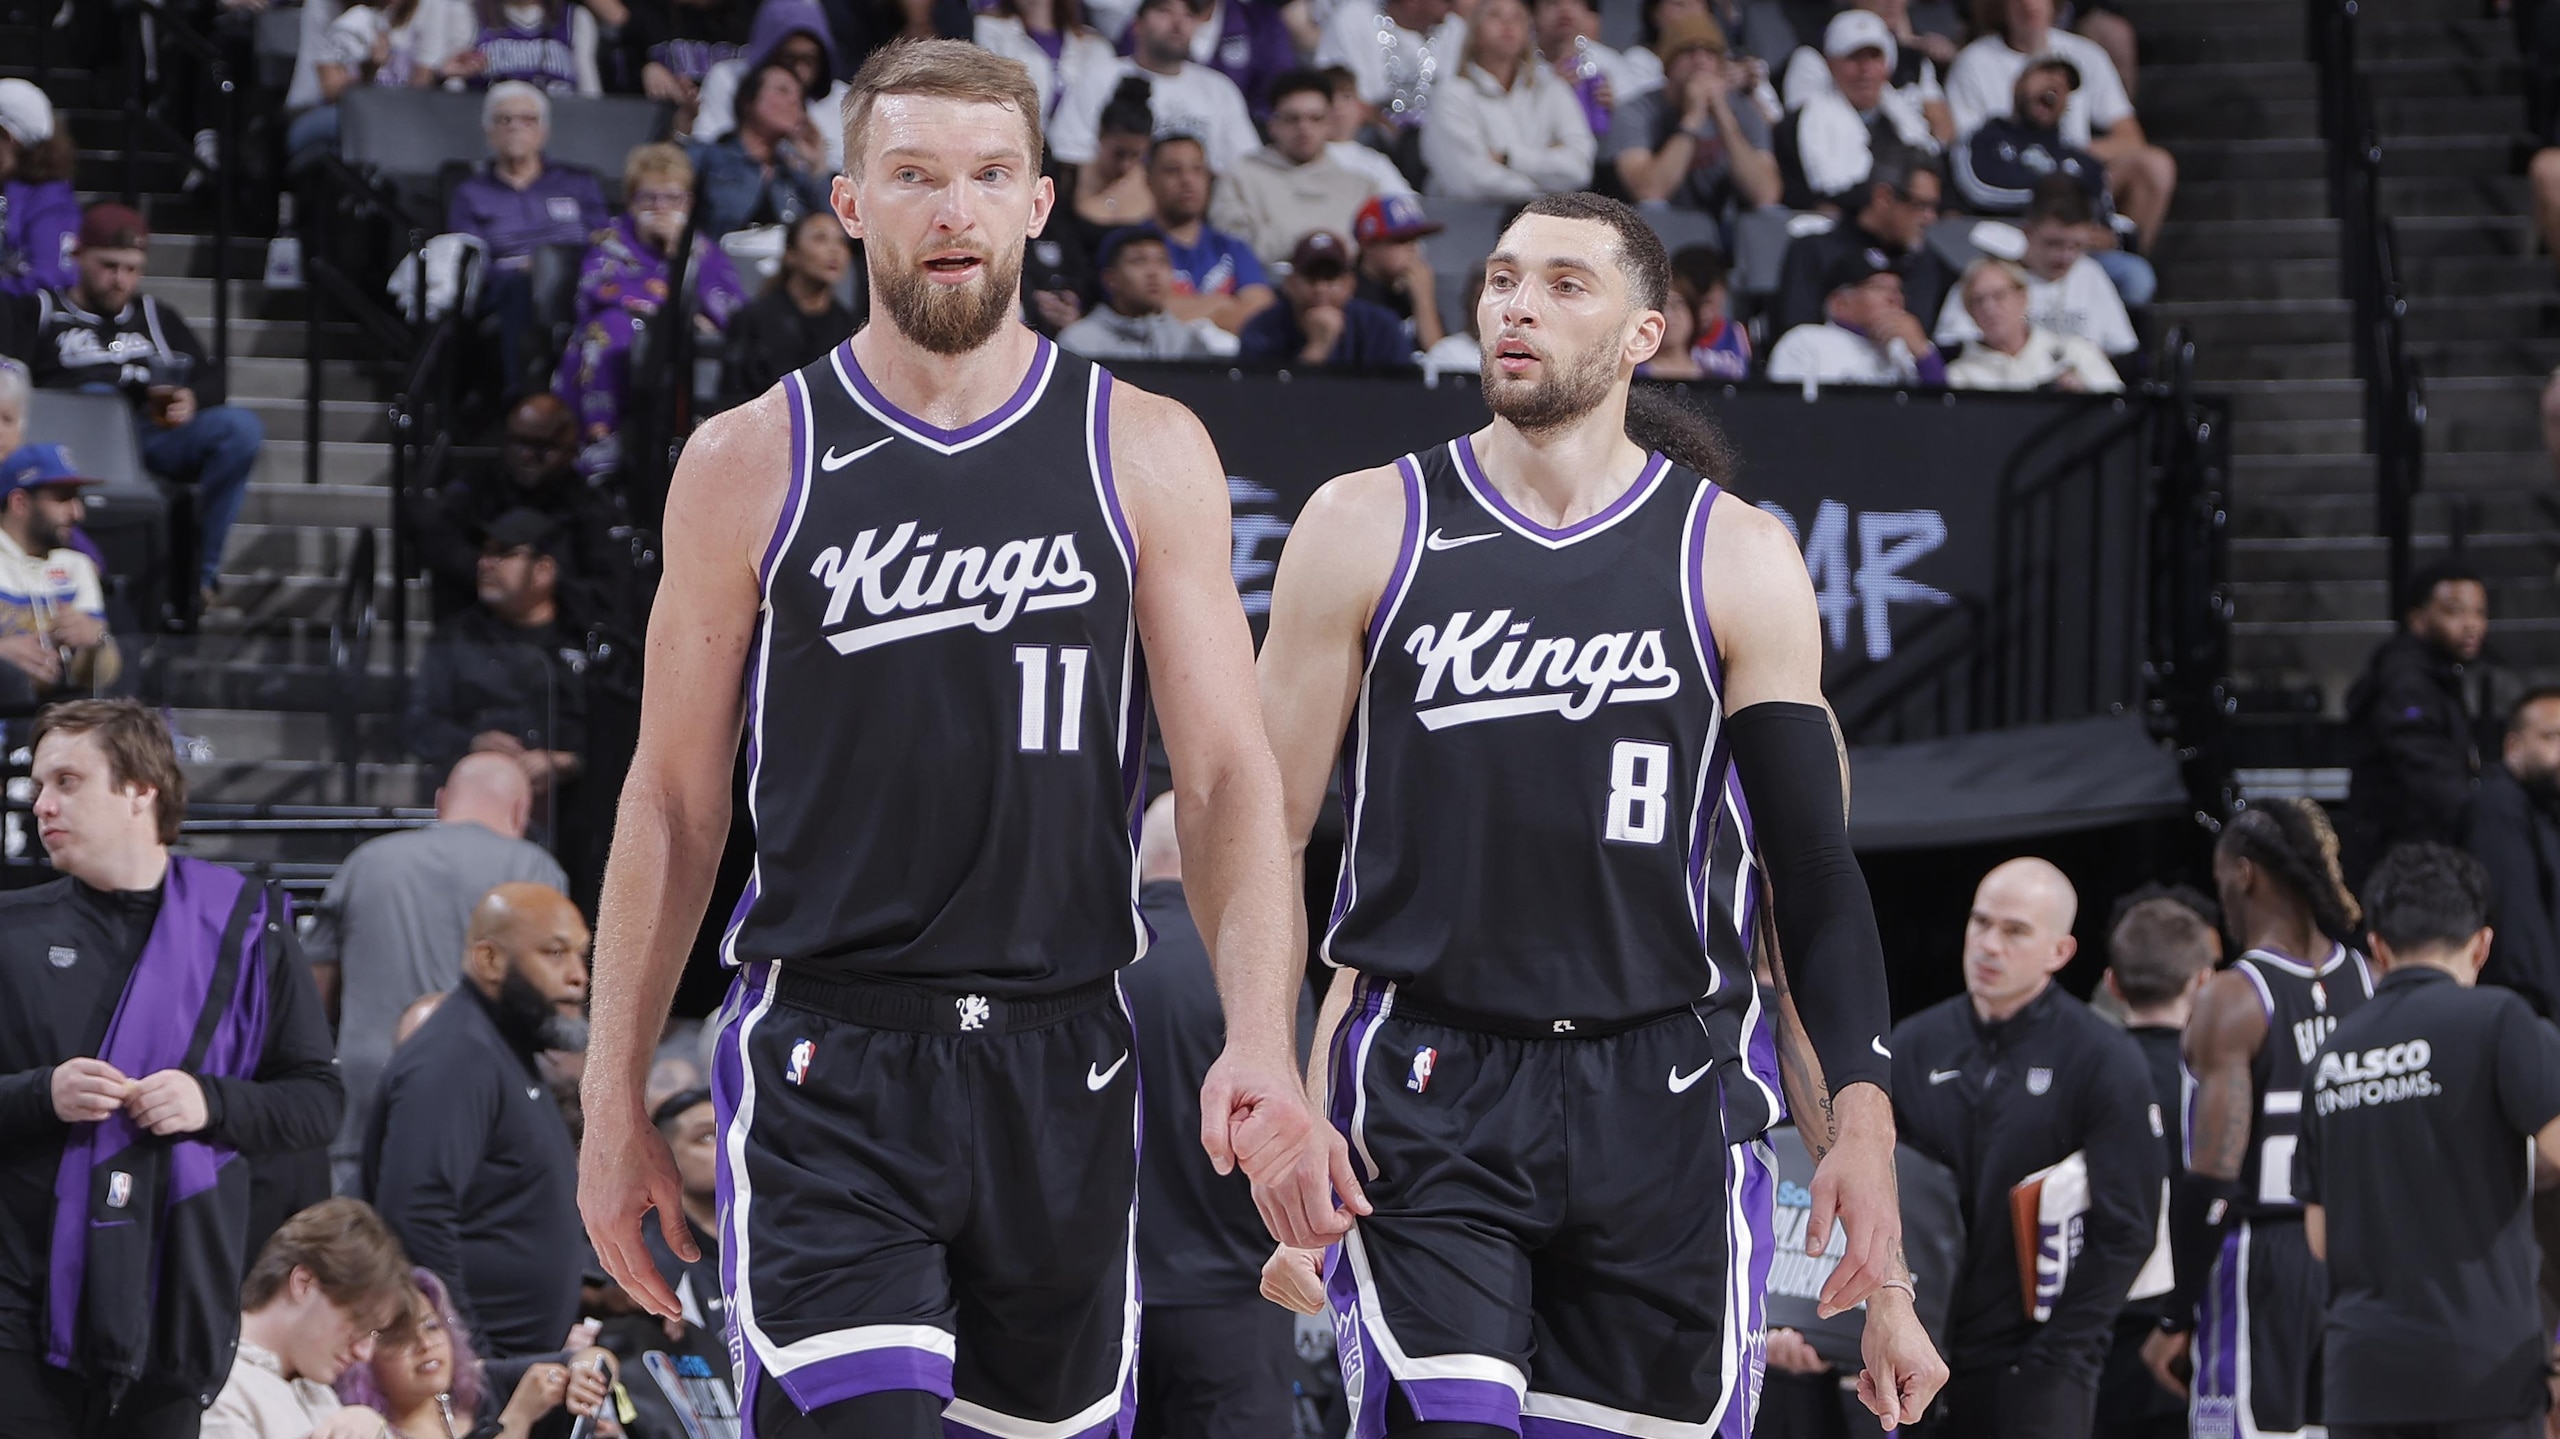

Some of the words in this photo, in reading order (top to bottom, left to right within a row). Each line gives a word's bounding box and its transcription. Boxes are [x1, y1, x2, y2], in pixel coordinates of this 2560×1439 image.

[810, 520, 1097, 655] Kings
[1014, 643, 1091, 753] 11
[1404, 609, 1680, 731] Kings
[1604, 737, 1671, 845] 8
[2314, 1039, 2431, 1091] ALSCO
